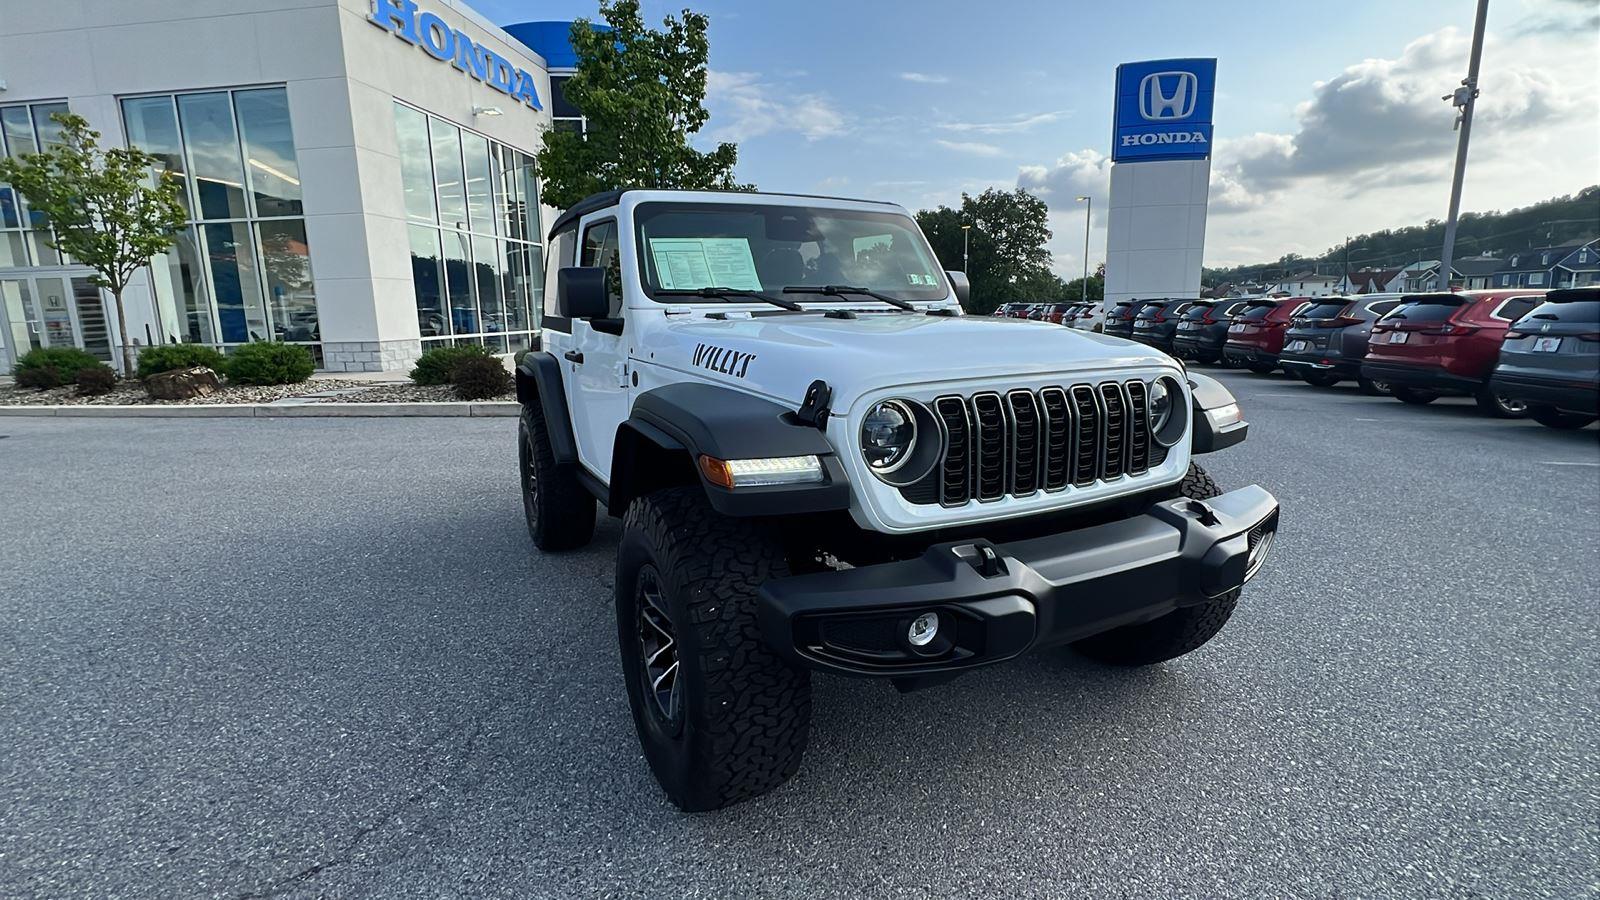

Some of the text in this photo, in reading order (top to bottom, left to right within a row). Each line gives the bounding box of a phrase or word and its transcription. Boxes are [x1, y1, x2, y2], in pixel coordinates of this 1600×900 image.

[366, 0, 543, 112] HONDA
[1121, 132, 1207, 147] HONDA
[692, 343, 757, 378] WILLYS
